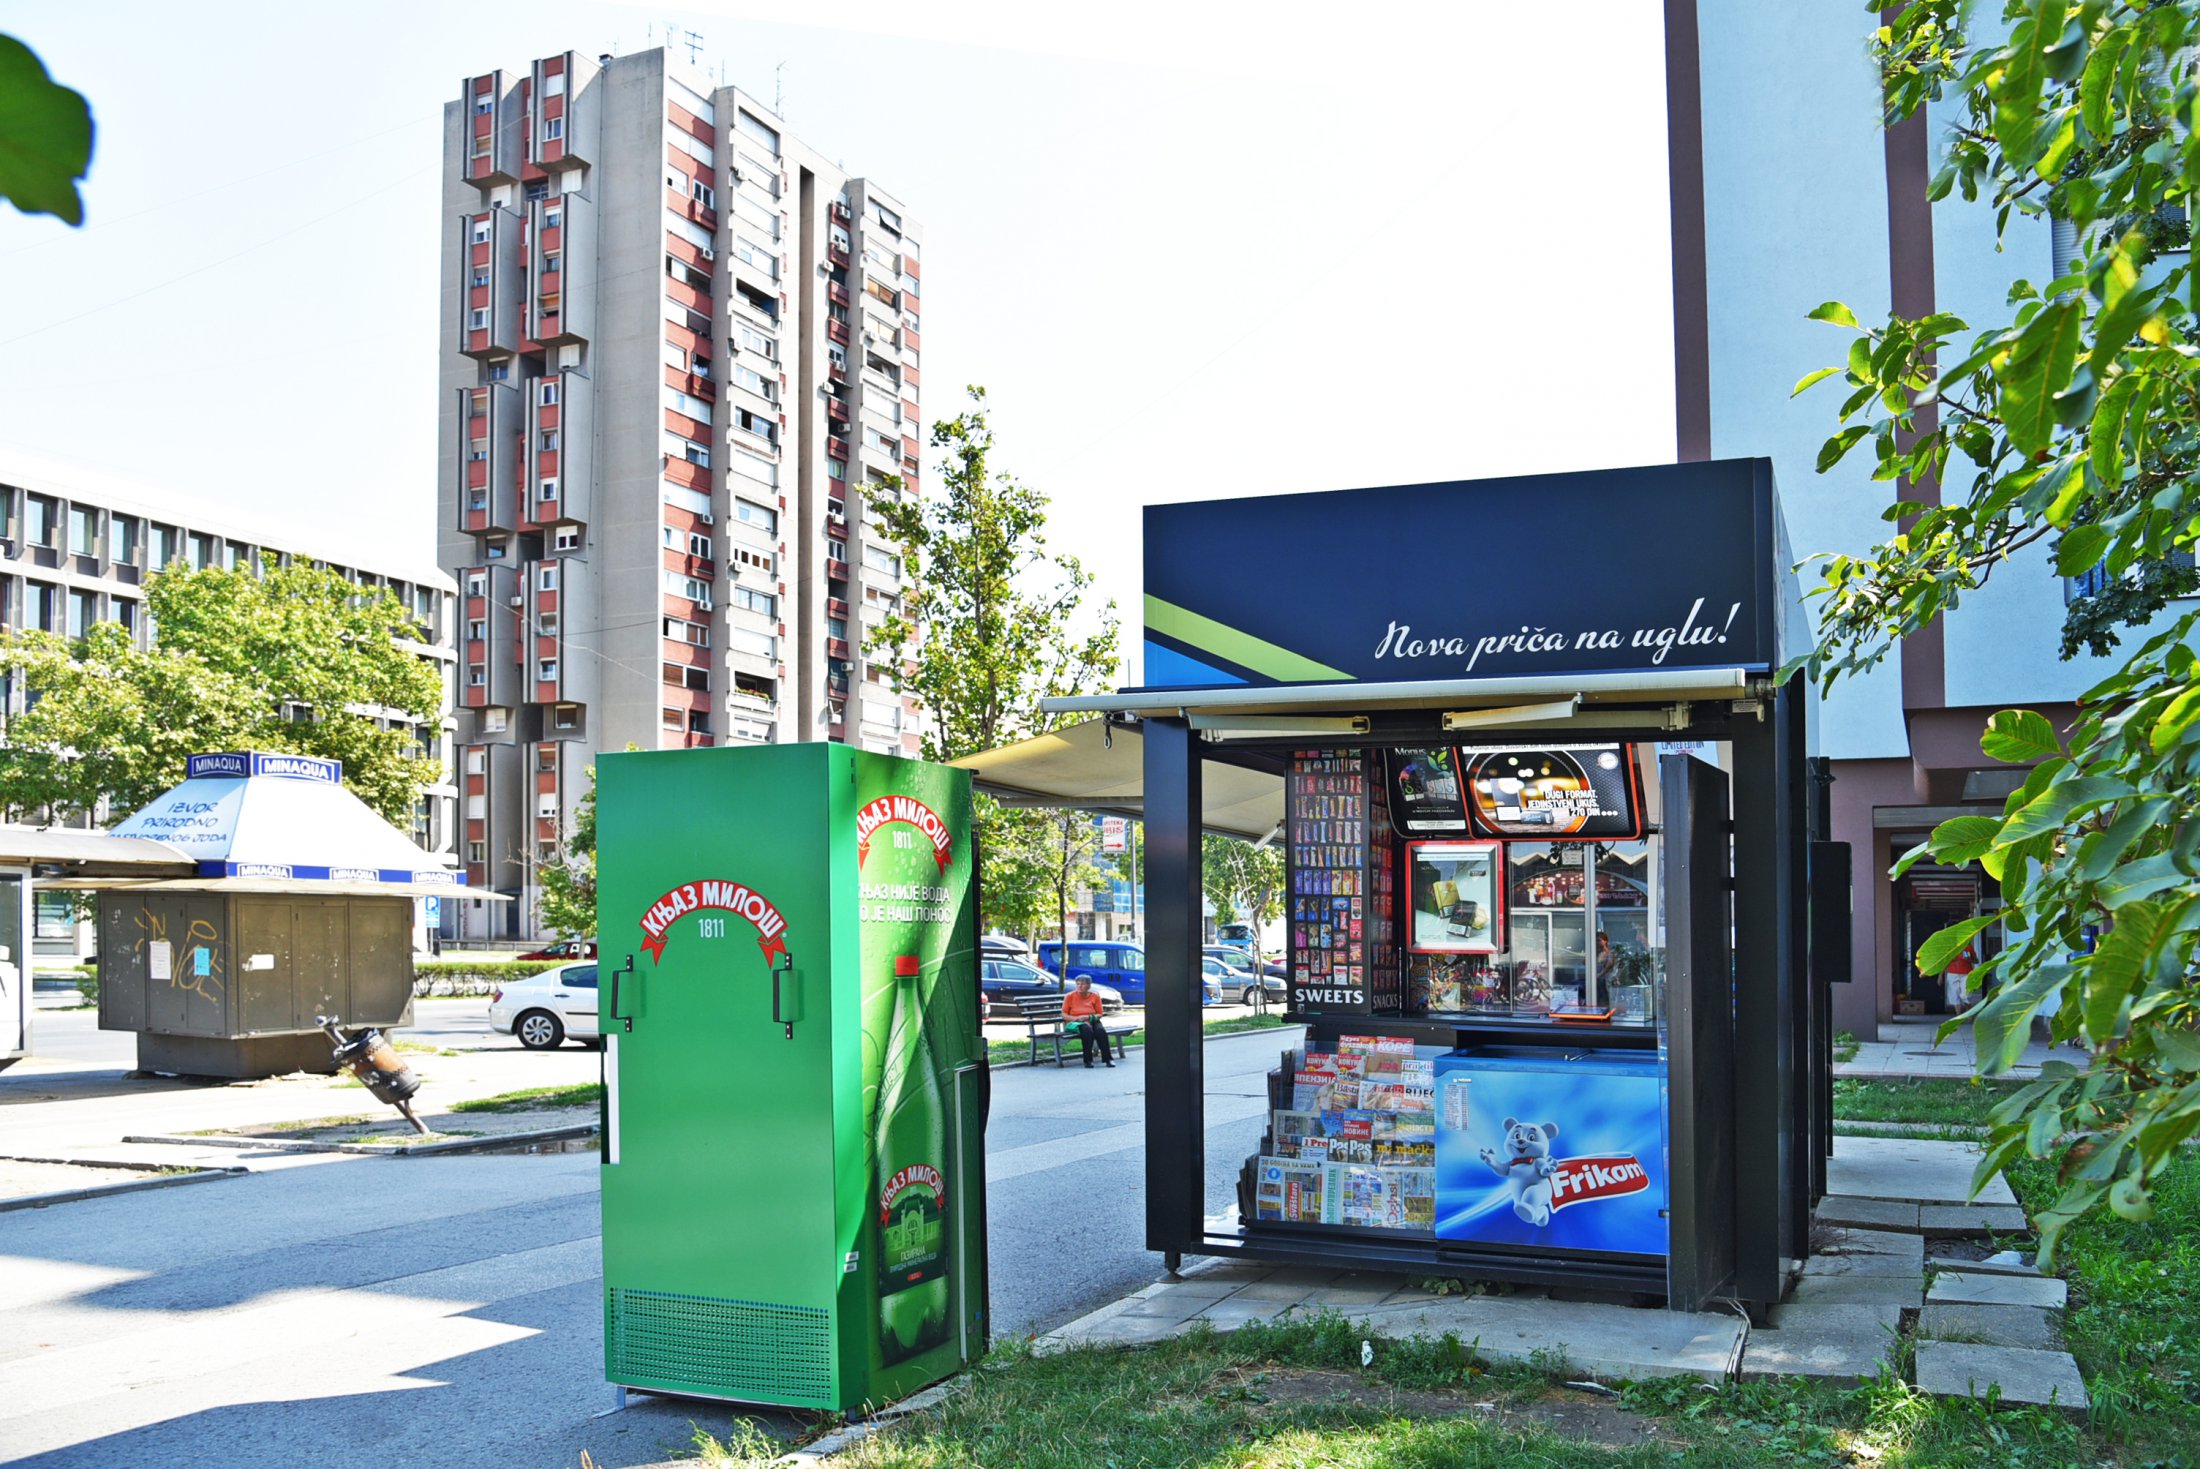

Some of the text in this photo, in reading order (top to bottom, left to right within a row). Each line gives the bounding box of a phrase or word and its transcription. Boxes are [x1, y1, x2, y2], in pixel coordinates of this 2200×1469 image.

[1375, 597, 1741, 672] Nova priča na uglu!
[195, 755, 242, 773] MINAQUA
[264, 757, 329, 780] MINAQUA
[168, 802, 219, 814] IZVOR
[141, 817, 219, 829] PRIRODNO
[894, 797, 950, 850] МИЛОШ
[192, 834, 228, 843] JODA
[893, 831, 912, 849] 1811
[241, 865, 288, 878] MINAQUA
[332, 869, 376, 881] MINAQUA
[415, 872, 453, 883] MINAQUA
[891, 884, 919, 901] НИЈЕ
[922, 885, 950, 903] ВОДА
[642, 881, 784, 939] КЊАЗ МИЛОШ
[871, 905, 884, 922] ЈЕ
[887, 906, 913, 923] НАШ
[915, 907, 951, 923] ПОНОС
[698, 919, 725, 938] 1811
[1295, 988, 1364, 1004] SWEETS
[1373, 994, 1398, 1010] SNACKS
[881, 1165, 944, 1210] КЊАЗ МИЛОШ
[1551, 1163, 1645, 1198] Frikom
